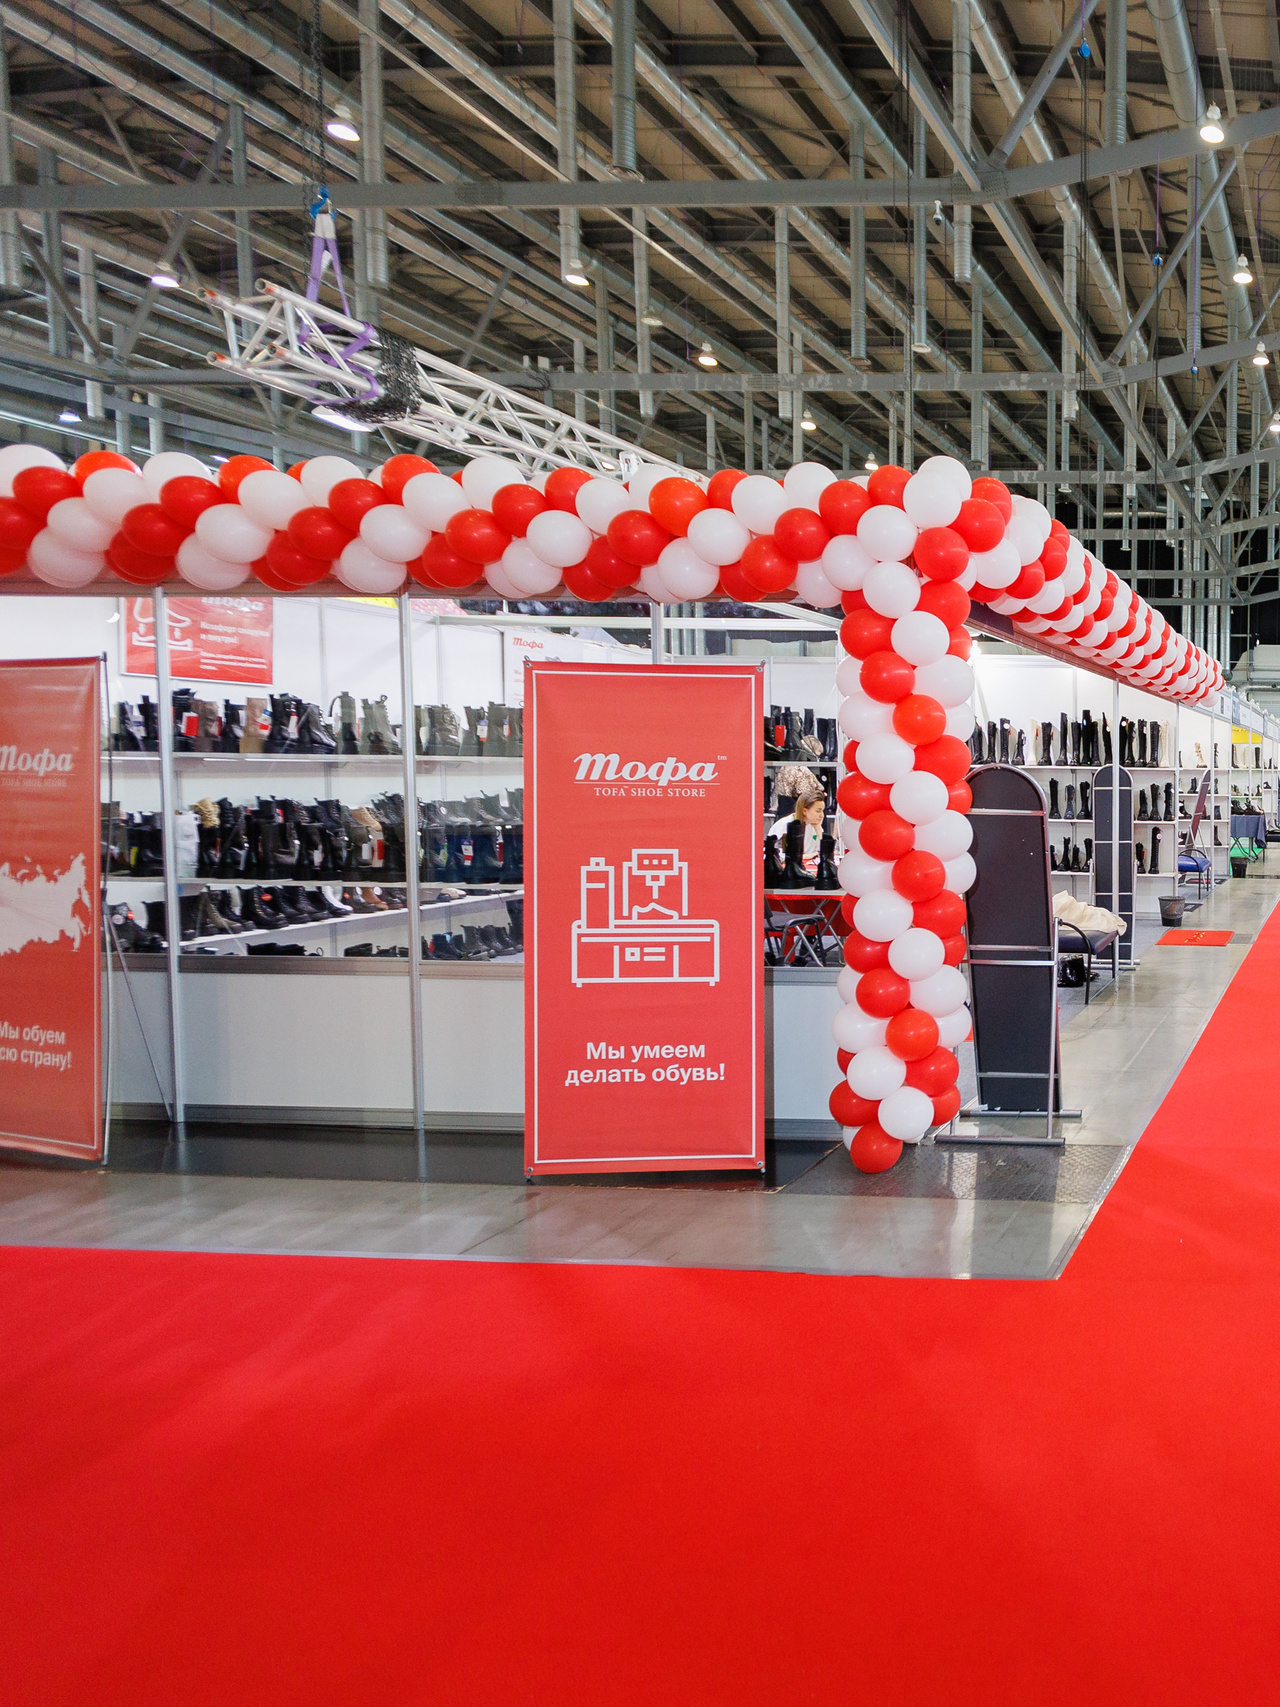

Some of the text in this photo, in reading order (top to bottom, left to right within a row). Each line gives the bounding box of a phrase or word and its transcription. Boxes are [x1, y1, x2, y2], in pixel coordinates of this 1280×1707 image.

[573, 752, 719, 787] Тофа
[630, 787, 663, 797] SHOE
[667, 787, 706, 797] STORE
[22, 1025, 66, 1046] обуем
[21, 1049, 72, 1071] страну!
[586, 1041, 706, 1063] Мы умеем
[565, 1063, 725, 1087] делать обувь!
